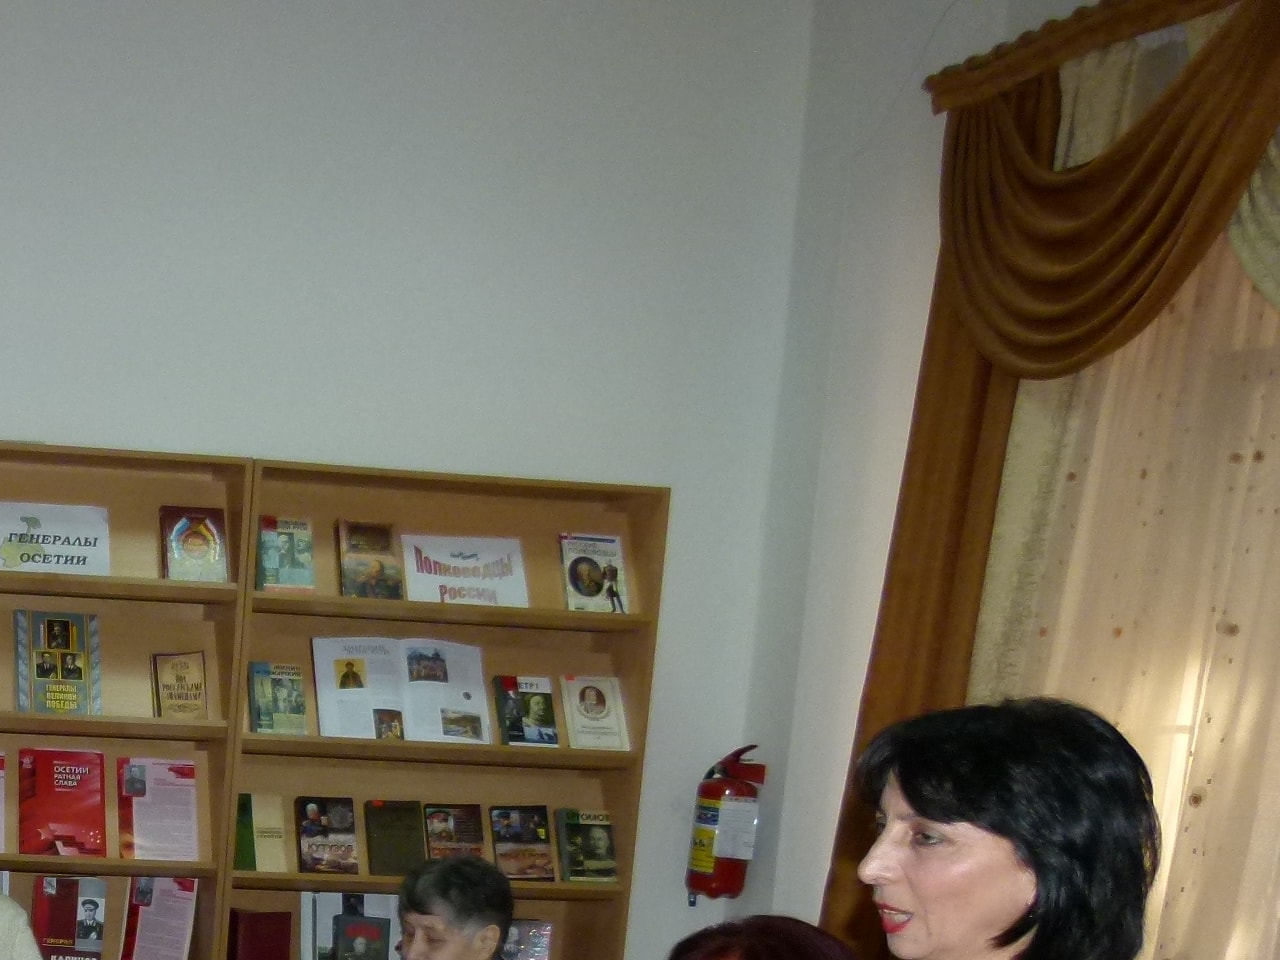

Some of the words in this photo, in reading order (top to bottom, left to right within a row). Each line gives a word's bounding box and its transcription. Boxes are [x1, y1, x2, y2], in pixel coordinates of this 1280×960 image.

[8, 532, 98, 547] ГЕНЕРАЛЫ
[20, 552, 88, 566] ОСЕТИИ
[414, 545, 513, 581] Полководцы
[439, 585, 497, 604] России
[46, 684, 77, 693] ГЕНЕРАЛЫ
[46, 693, 77, 701] ВЕЛИКОЙ
[46, 700, 77, 710] ПОБЕДЫ
[54, 766, 90, 774] ОСЕТИИ
[307, 843, 354, 853] КУТУЗОВ
